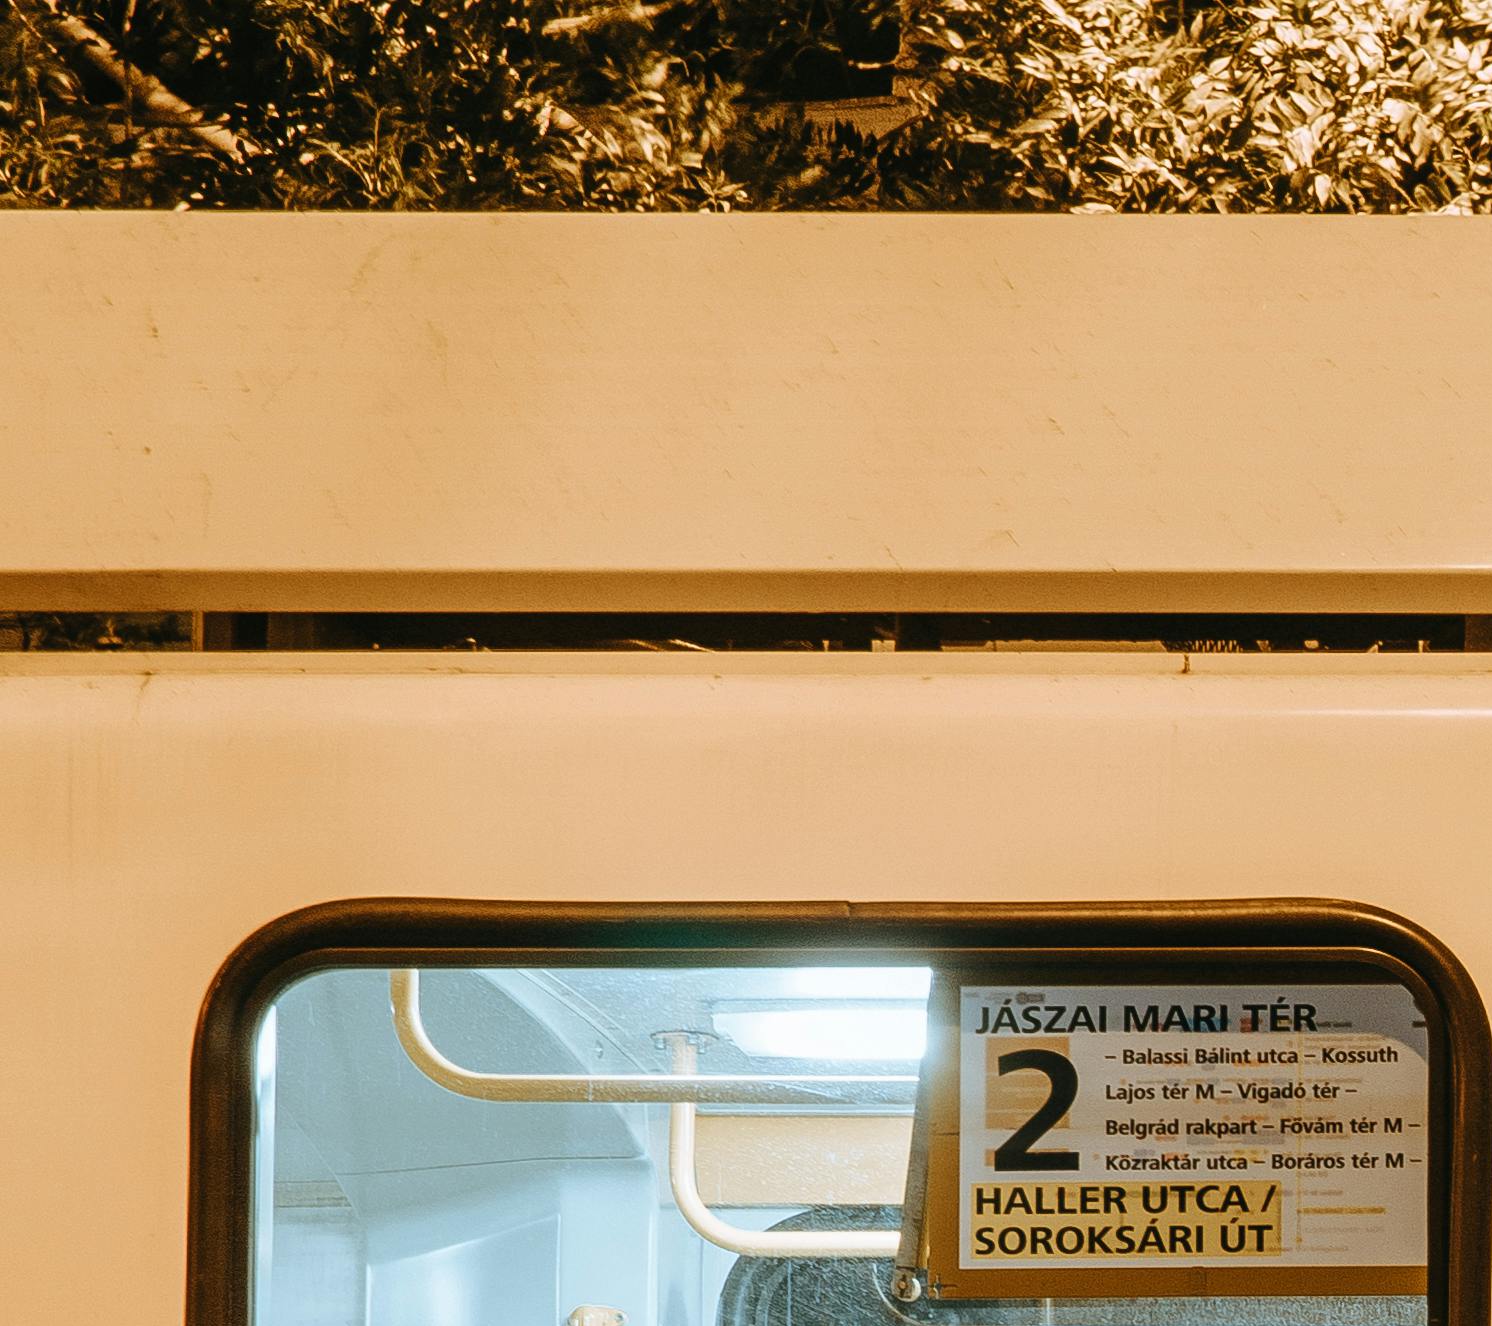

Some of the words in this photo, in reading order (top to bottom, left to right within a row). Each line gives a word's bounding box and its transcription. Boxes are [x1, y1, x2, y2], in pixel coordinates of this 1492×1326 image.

[975, 997, 1107, 1035] JÁSZAI
[1123, 1004, 1230, 1034] MARI
[1241, 997, 1318, 1034] TÉR
[1122, 1047, 1188, 1065] Balassi
[1195, 1047, 1252, 1065] Bálint
[1257, 1048, 1299, 1065] utca
[1321, 1045, 1399, 1064] Kossuth
[1105, 1082, 1155, 1104] Lajos
[1161, 1082, 1190, 1101] tér
[1195, 1083, 1215, 1101] M
[1237, 1081, 1307, 1104] Vigadó
[1312, 1081, 1341, 1100] tér
[994, 1048, 1080, 1173] 2
[1105, 1118, 1179, 1140] Belgrád
[1185, 1118, 1258, 1140] rakpart
[1279, 1115, 1344, 1136] Fővám
[1349, 1116, 1378, 1135] tér
[1383, 1117, 1403, 1135] M
[1105, 1152, 1200, 1172] Közraktár
[1206, 1154, 1248, 1171] utca
[1271, 1151, 1346, 1171] Boráros
[1351, 1151, 1380, 1170] tér
[1385, 1152, 1404, 1169] M
[975, 1186, 1127, 1215] HALLER
[1142, 1185, 1250, 1215] UTCA
[974, 1218, 1204, 1256] SOROKSÁRI
[1219, 1217, 1274, 1254] ÚT
